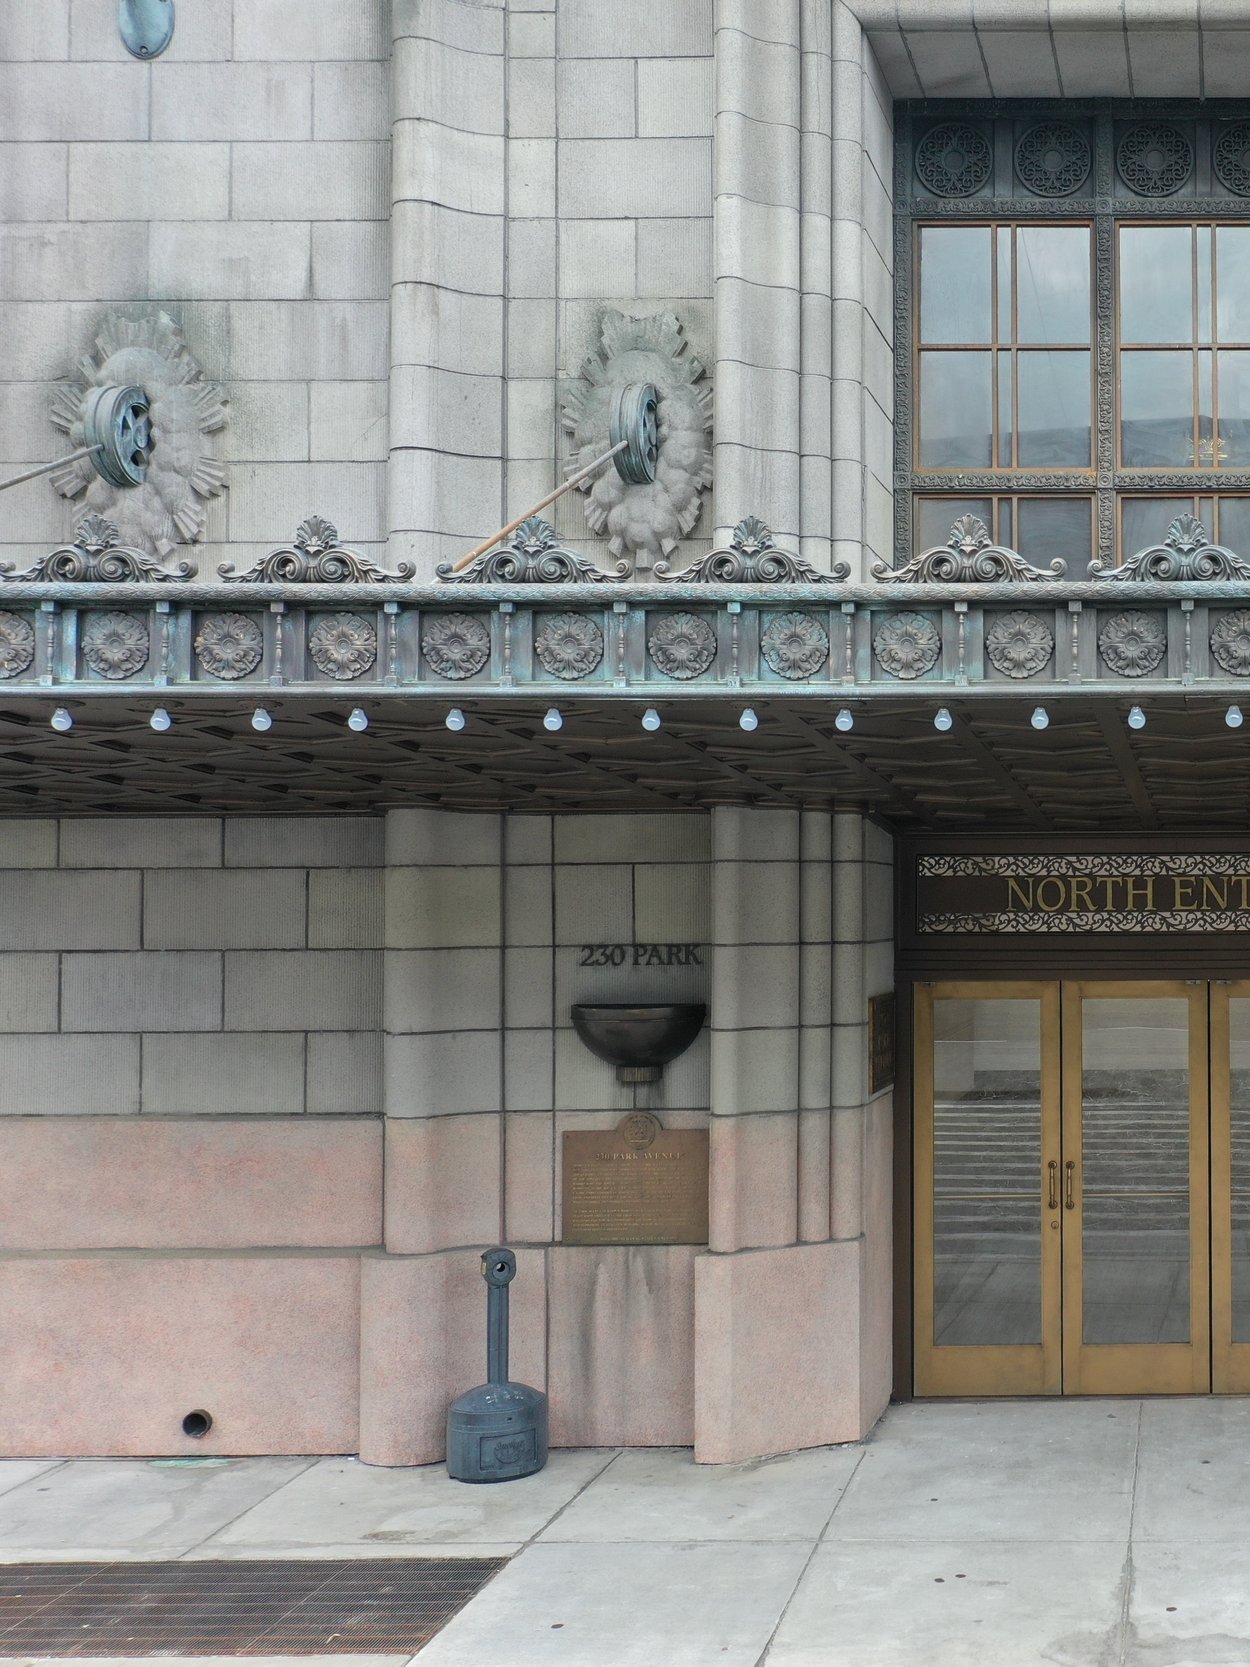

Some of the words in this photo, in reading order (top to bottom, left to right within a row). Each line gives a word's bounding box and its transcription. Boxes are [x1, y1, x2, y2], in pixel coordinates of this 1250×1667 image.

[1006, 876, 1155, 912] NORTH
[580, 944, 625, 966] 230
[632, 943, 702, 966] PARK
[613, 1152, 639, 1160] PARK
